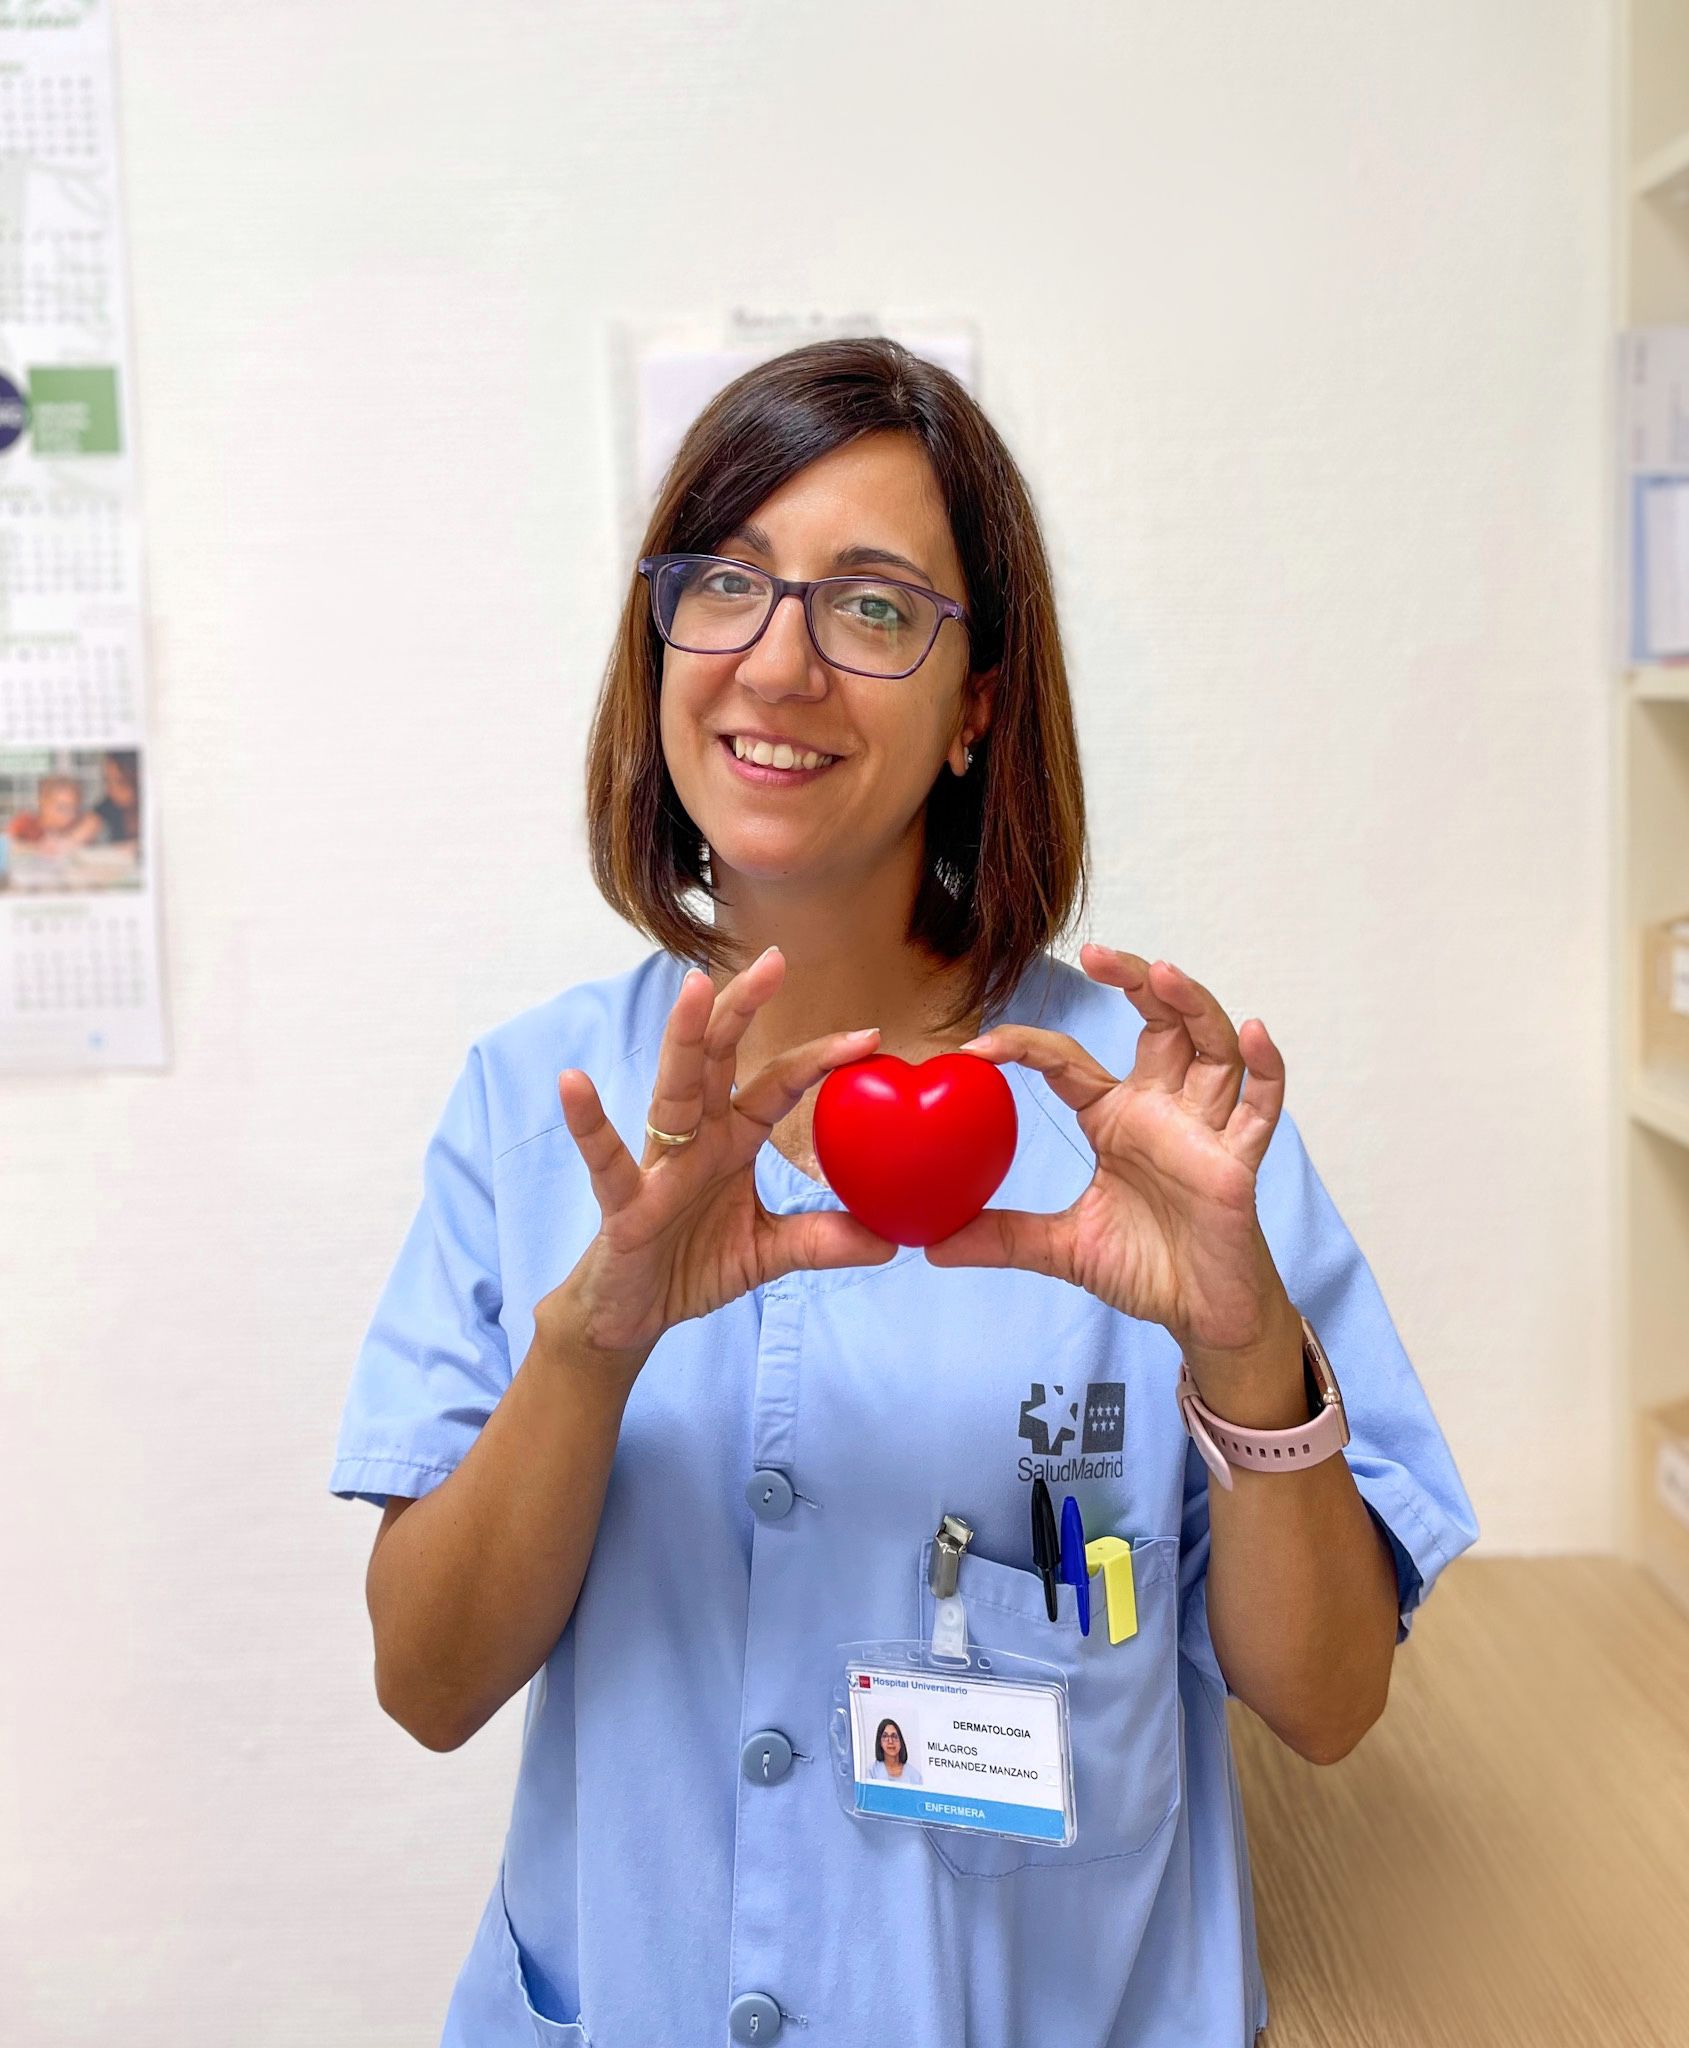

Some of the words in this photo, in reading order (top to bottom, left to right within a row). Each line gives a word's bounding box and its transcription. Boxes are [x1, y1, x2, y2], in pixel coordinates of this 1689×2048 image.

[1017, 1456, 1123, 1482] SaludMadrid
[872, 1677, 908, 1689] Hospital
[911, 1681, 968, 1695] Universitario
[953, 1720, 1031, 1738] DERMATOLOGIA
[927, 1741, 978, 1756] MILAGROS
[928, 1757, 987, 1773] FERNANDEZ
[989, 1765, 1039, 1780] MANZANO
[925, 1802, 986, 1818] ENFERMERA
